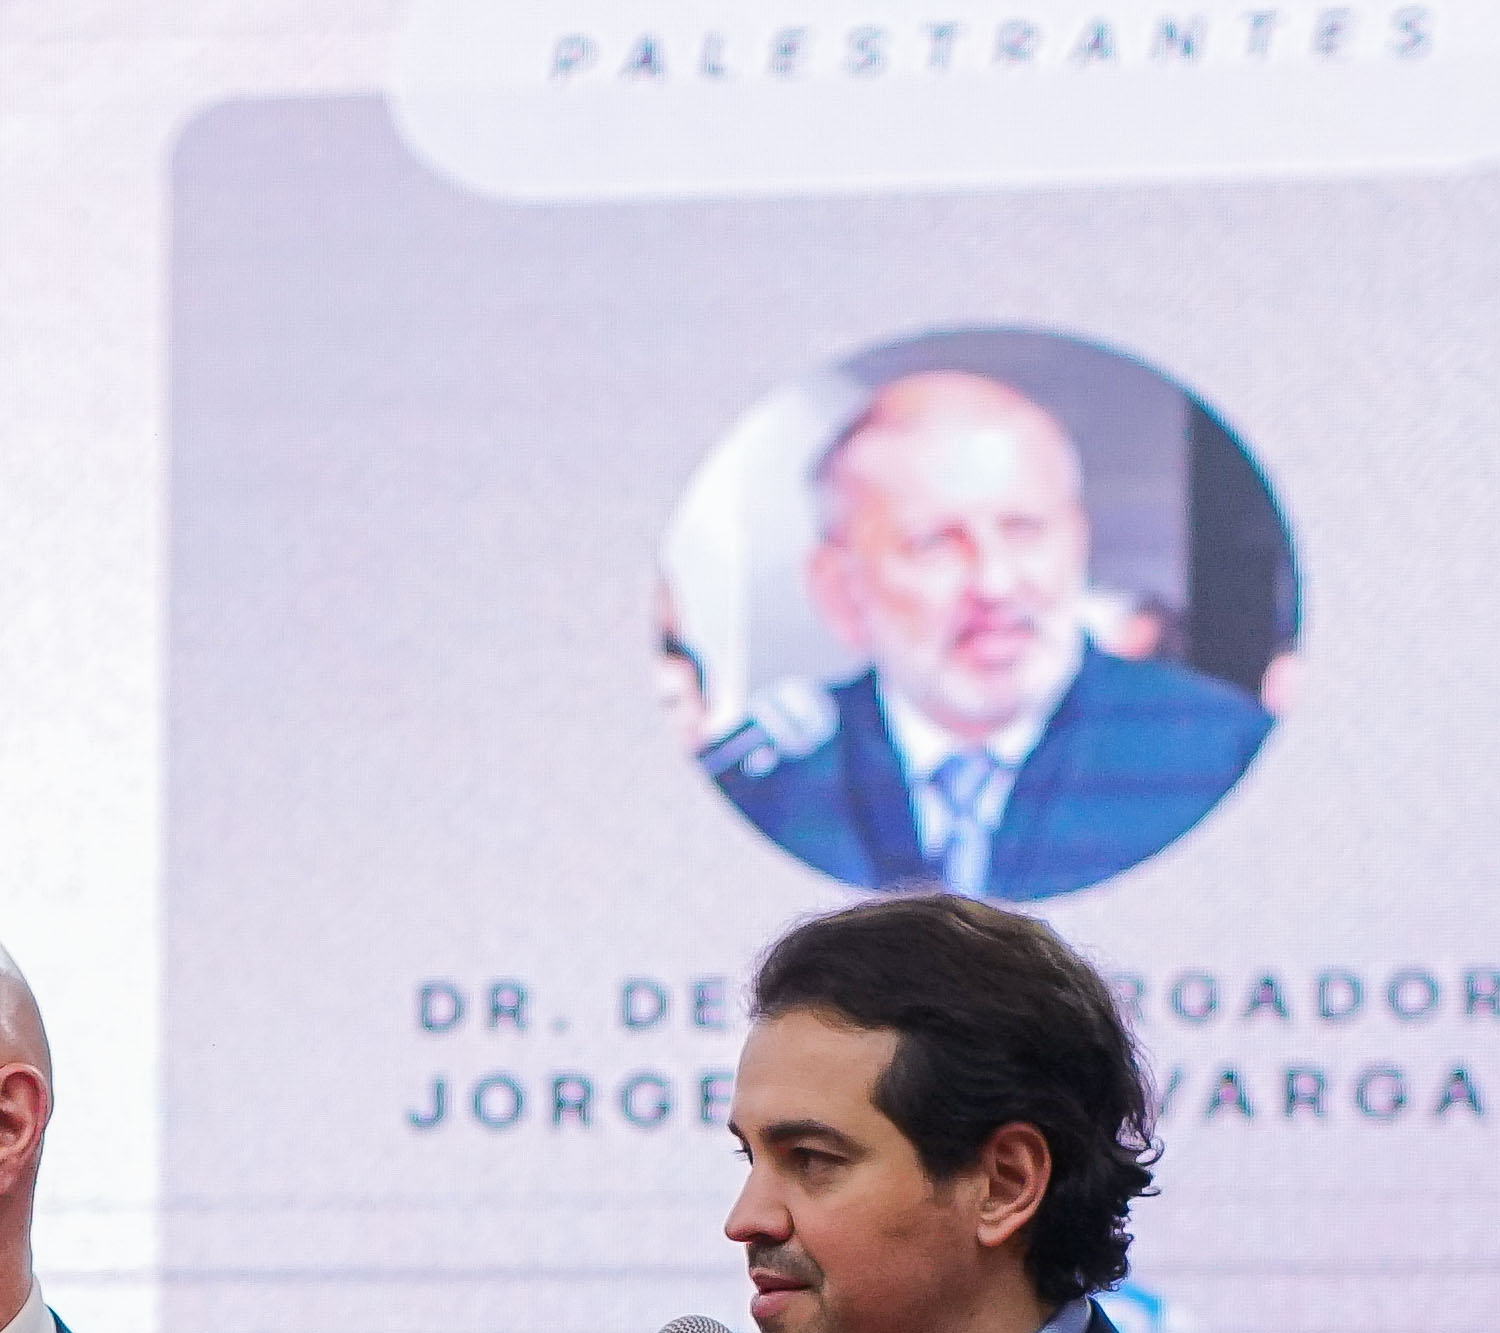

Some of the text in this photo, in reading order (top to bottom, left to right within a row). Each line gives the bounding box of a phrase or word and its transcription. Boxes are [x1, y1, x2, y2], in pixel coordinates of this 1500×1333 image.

[550, 8, 1434, 81] PALESTRANTES
[419, 978, 567, 1030] DR.
[409, 1072, 735, 1128] JORGE
